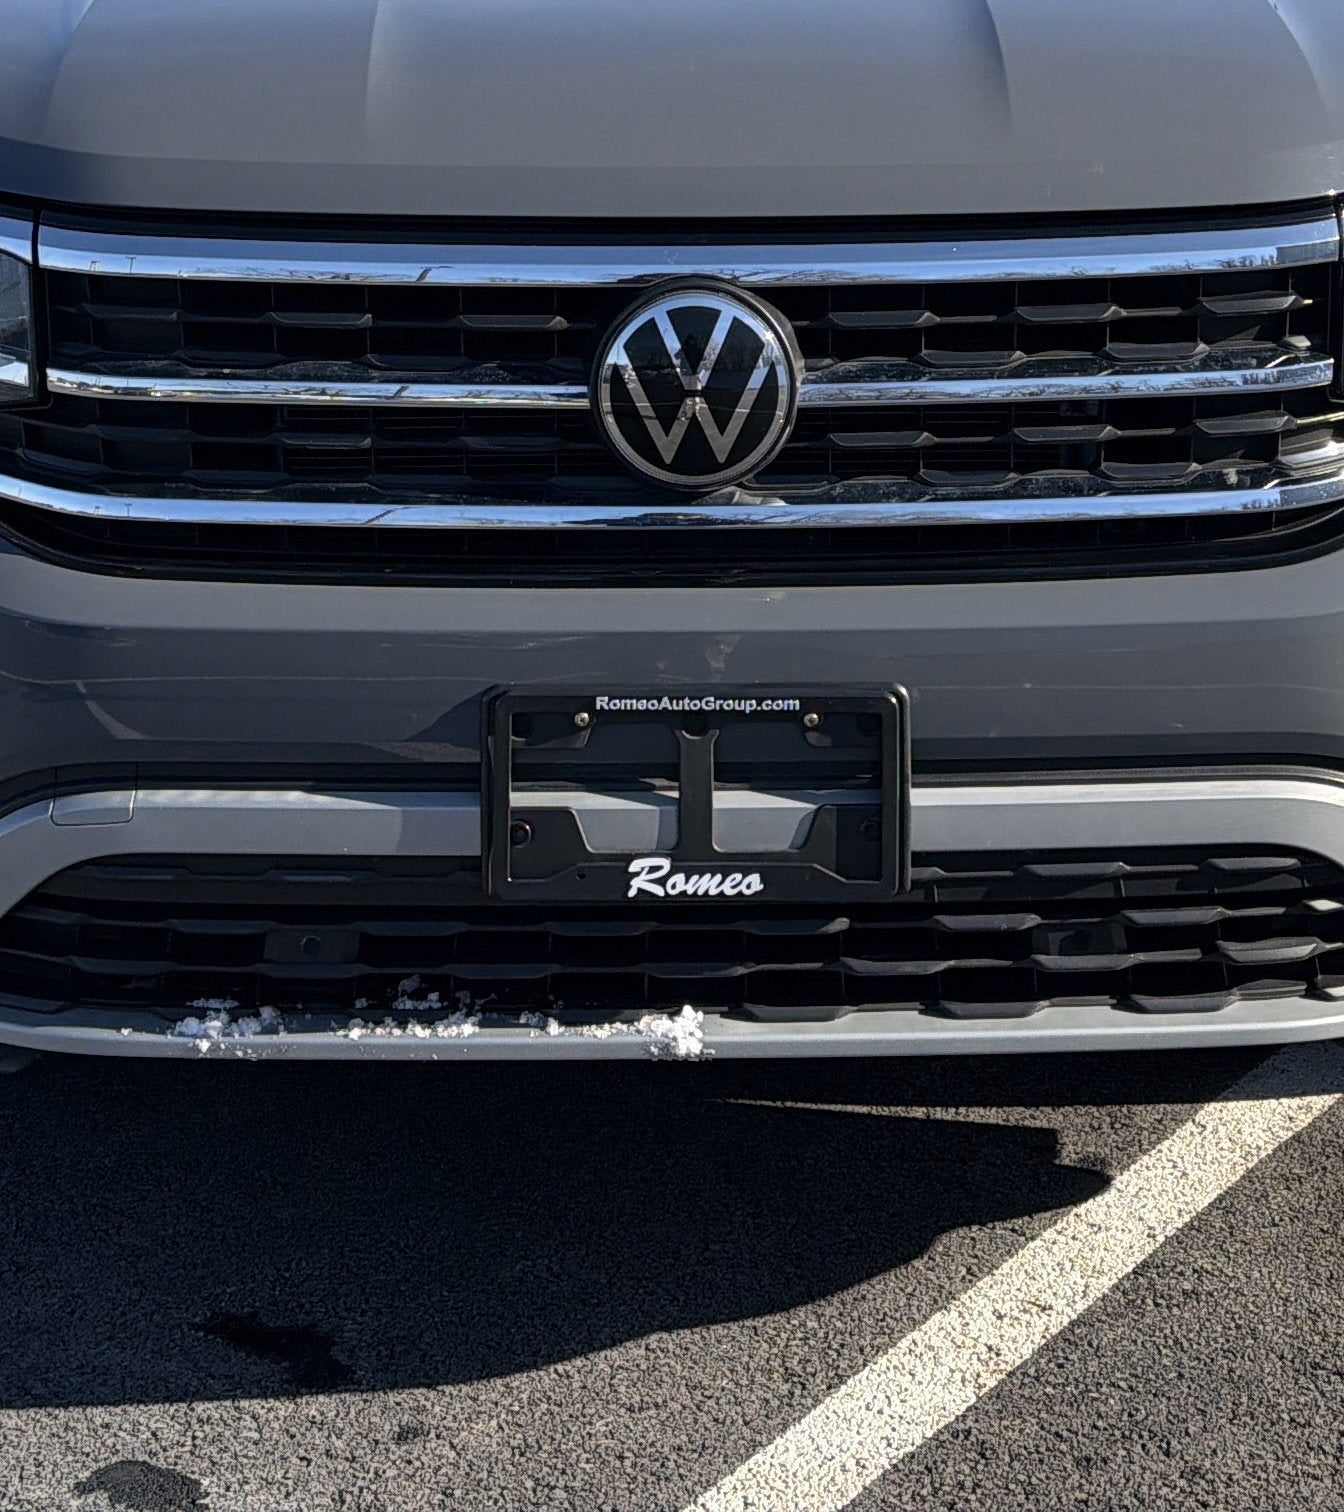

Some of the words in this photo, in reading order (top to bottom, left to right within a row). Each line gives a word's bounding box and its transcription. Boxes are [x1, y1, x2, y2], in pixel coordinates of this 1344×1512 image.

[606, 298, 786, 473] VW
[594, 695, 801, 714] RomeoAutoGroup.com
[627, 856, 765, 899] Romeo
